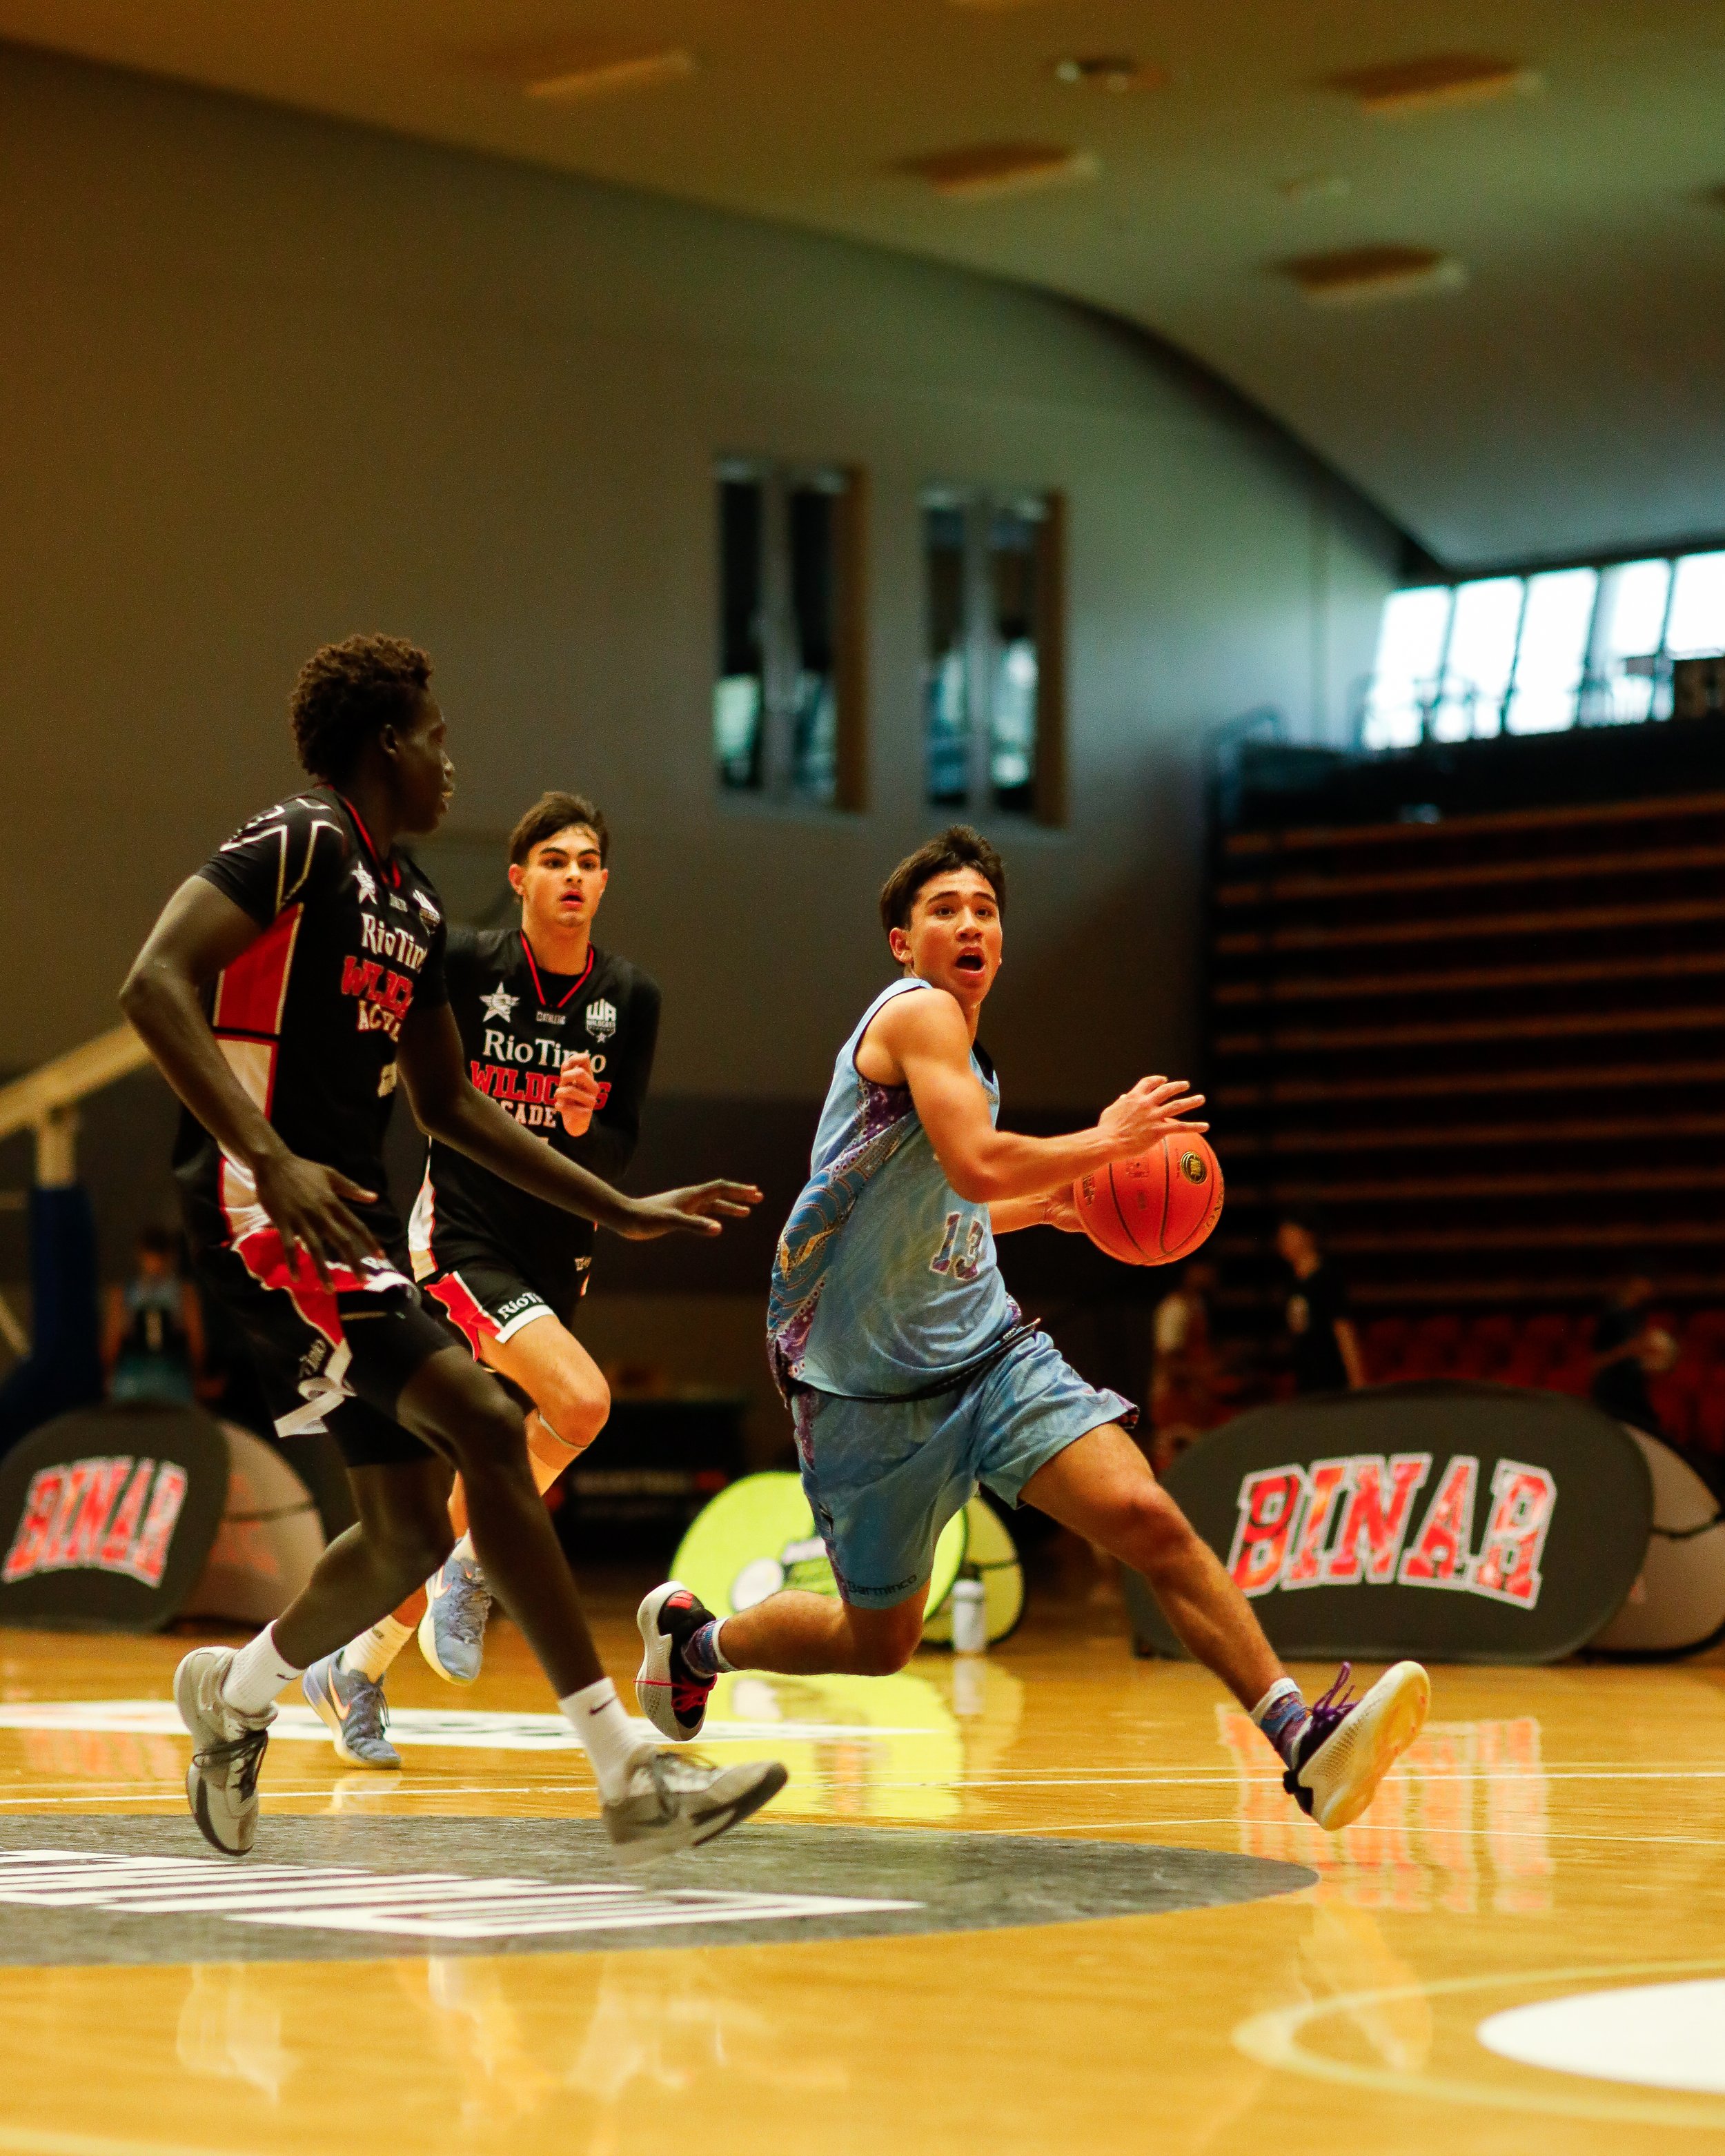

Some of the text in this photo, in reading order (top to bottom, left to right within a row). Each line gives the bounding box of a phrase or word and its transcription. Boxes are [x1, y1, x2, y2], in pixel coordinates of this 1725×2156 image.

[470, 1060, 612, 1111] WILDCS
[929, 1211, 985, 1282] 13
[1, 1455, 188, 1589] BINAR
[1227, 1452, 1557, 1610] BINAR
